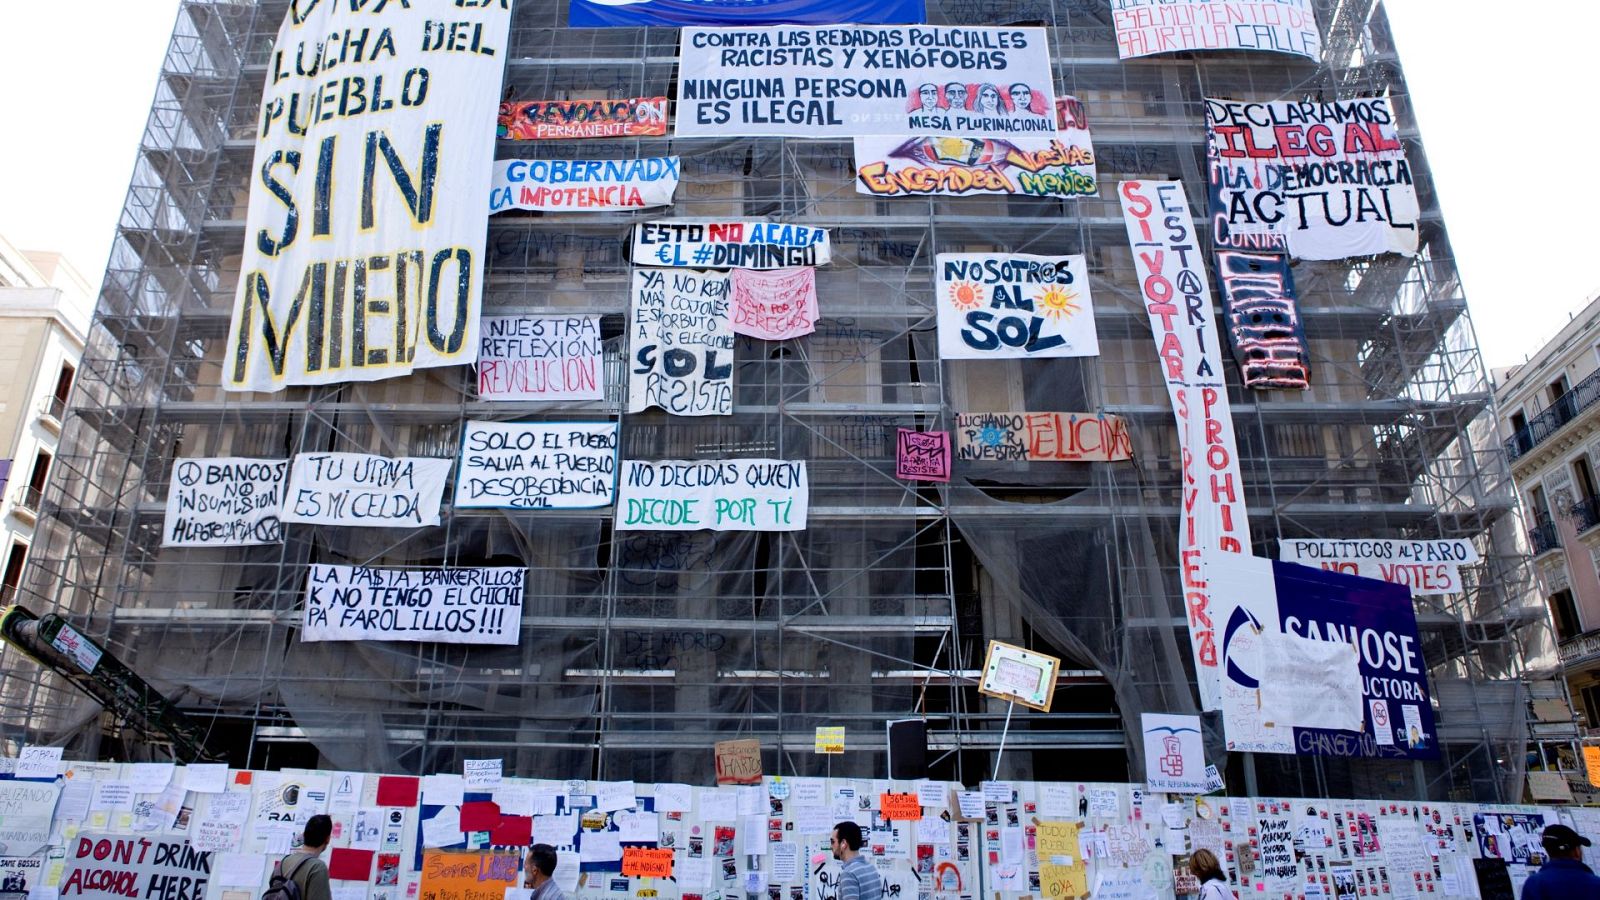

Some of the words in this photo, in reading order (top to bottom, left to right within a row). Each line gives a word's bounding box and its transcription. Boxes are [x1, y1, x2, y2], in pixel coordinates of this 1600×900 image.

[692, 31, 770, 49] CONTRA
[777, 30, 810, 48] LAS
[816, 28, 904, 48] REDADAS
[909, 27, 1028, 49] POLICIALES
[1235, 24, 1316, 57] CALLE
[273, 28, 396, 85] LUCHA
[422, 20, 495, 56] DEL
[720, 48, 834, 68] RACISTAS
[843, 49, 860, 69] Y
[863, 48, 1008, 70] XENÓFOBAS
[683, 78, 785, 101] NINGUNA
[794, 78, 908, 99] PERSONA
[262, 68, 429, 138] PUEBLO
[696, 101, 731, 126] ES
[741, 100, 843, 126] ILEGAL
[1206, 99, 1391, 127] DECLARAMOS
[537, 122, 633, 138] PERMANENTE
[908, 115, 951, 131] MESA
[956, 116, 1056, 132] PLURINACIONAL
[1213, 122, 1401, 159] ILEGAL
[1223, 164, 1253, 190] LA
[1265, 159, 1412, 191] DEMOCRACIA
[257, 123, 442, 257] SIN
[519, 185, 645, 208] IMPOTENCIA
[1229, 187, 1415, 231] ACTUAL
[641, 223, 703, 245] ESTO
[708, 223, 744, 243] NO
[750, 223, 824, 247] ACABA
[639, 271, 665, 289] YA
[673, 274, 697, 294] NO
[943, 259, 1075, 285] NOSOTR@S
[670, 295, 729, 320] COJONES
[990, 285, 1034, 313] AL
[233, 247, 472, 383] MIEDO
[490, 315, 596, 337] NUESTRA
[734, 305, 811, 333] DERECHOS
[639, 325, 648, 339] A
[960, 310, 1067, 353] SOL
[634, 344, 733, 380] SOL
[958, 413, 1024, 429] LUCHANDO
[469, 430, 535, 451] SOLO
[543, 432, 563, 449] EL
[568, 431, 618, 450] PUEBLO
[959, 444, 1030, 460] NUESTRA
[205, 462, 287, 485] BANCOS
[309, 456, 344, 483] TU
[353, 458, 415, 489] URNA
[467, 454, 524, 472] SALVA
[530, 454, 550, 469] AL
[554, 453, 614, 475] PUEBLO
[628, 463, 655, 488] NO
[660, 462, 737, 488] DECIDAS
[745, 462, 801, 488] QUIEN
[293, 489, 322, 518] ES
[327, 489, 351, 520] MI
[351, 493, 423, 523] CELDA
[509, 497, 553, 508] CIVIL
[624, 498, 701, 526] DECIDE
[715, 498, 757, 526] POR
[1295, 541, 1392, 560] POLITICOS
[1410, 542, 1468, 562] PARO
[312, 566, 341, 585] LA
[1379, 563, 1452, 590] VOTES
[333, 587, 362, 608] NO
[368, 586, 433, 608] TENGO
[444, 587, 466, 606] EL
[470, 585, 522, 607] CHICHI
[340, 607, 504, 635] FAROLILLOS!!!
[17, 859, 41, 868] BOSSES
[76, 837, 152, 864] DON'T
[153, 839, 213, 874] DRINK
[61, 868, 140, 898] ALCOHOL
[146, 873, 208, 900] HERE
